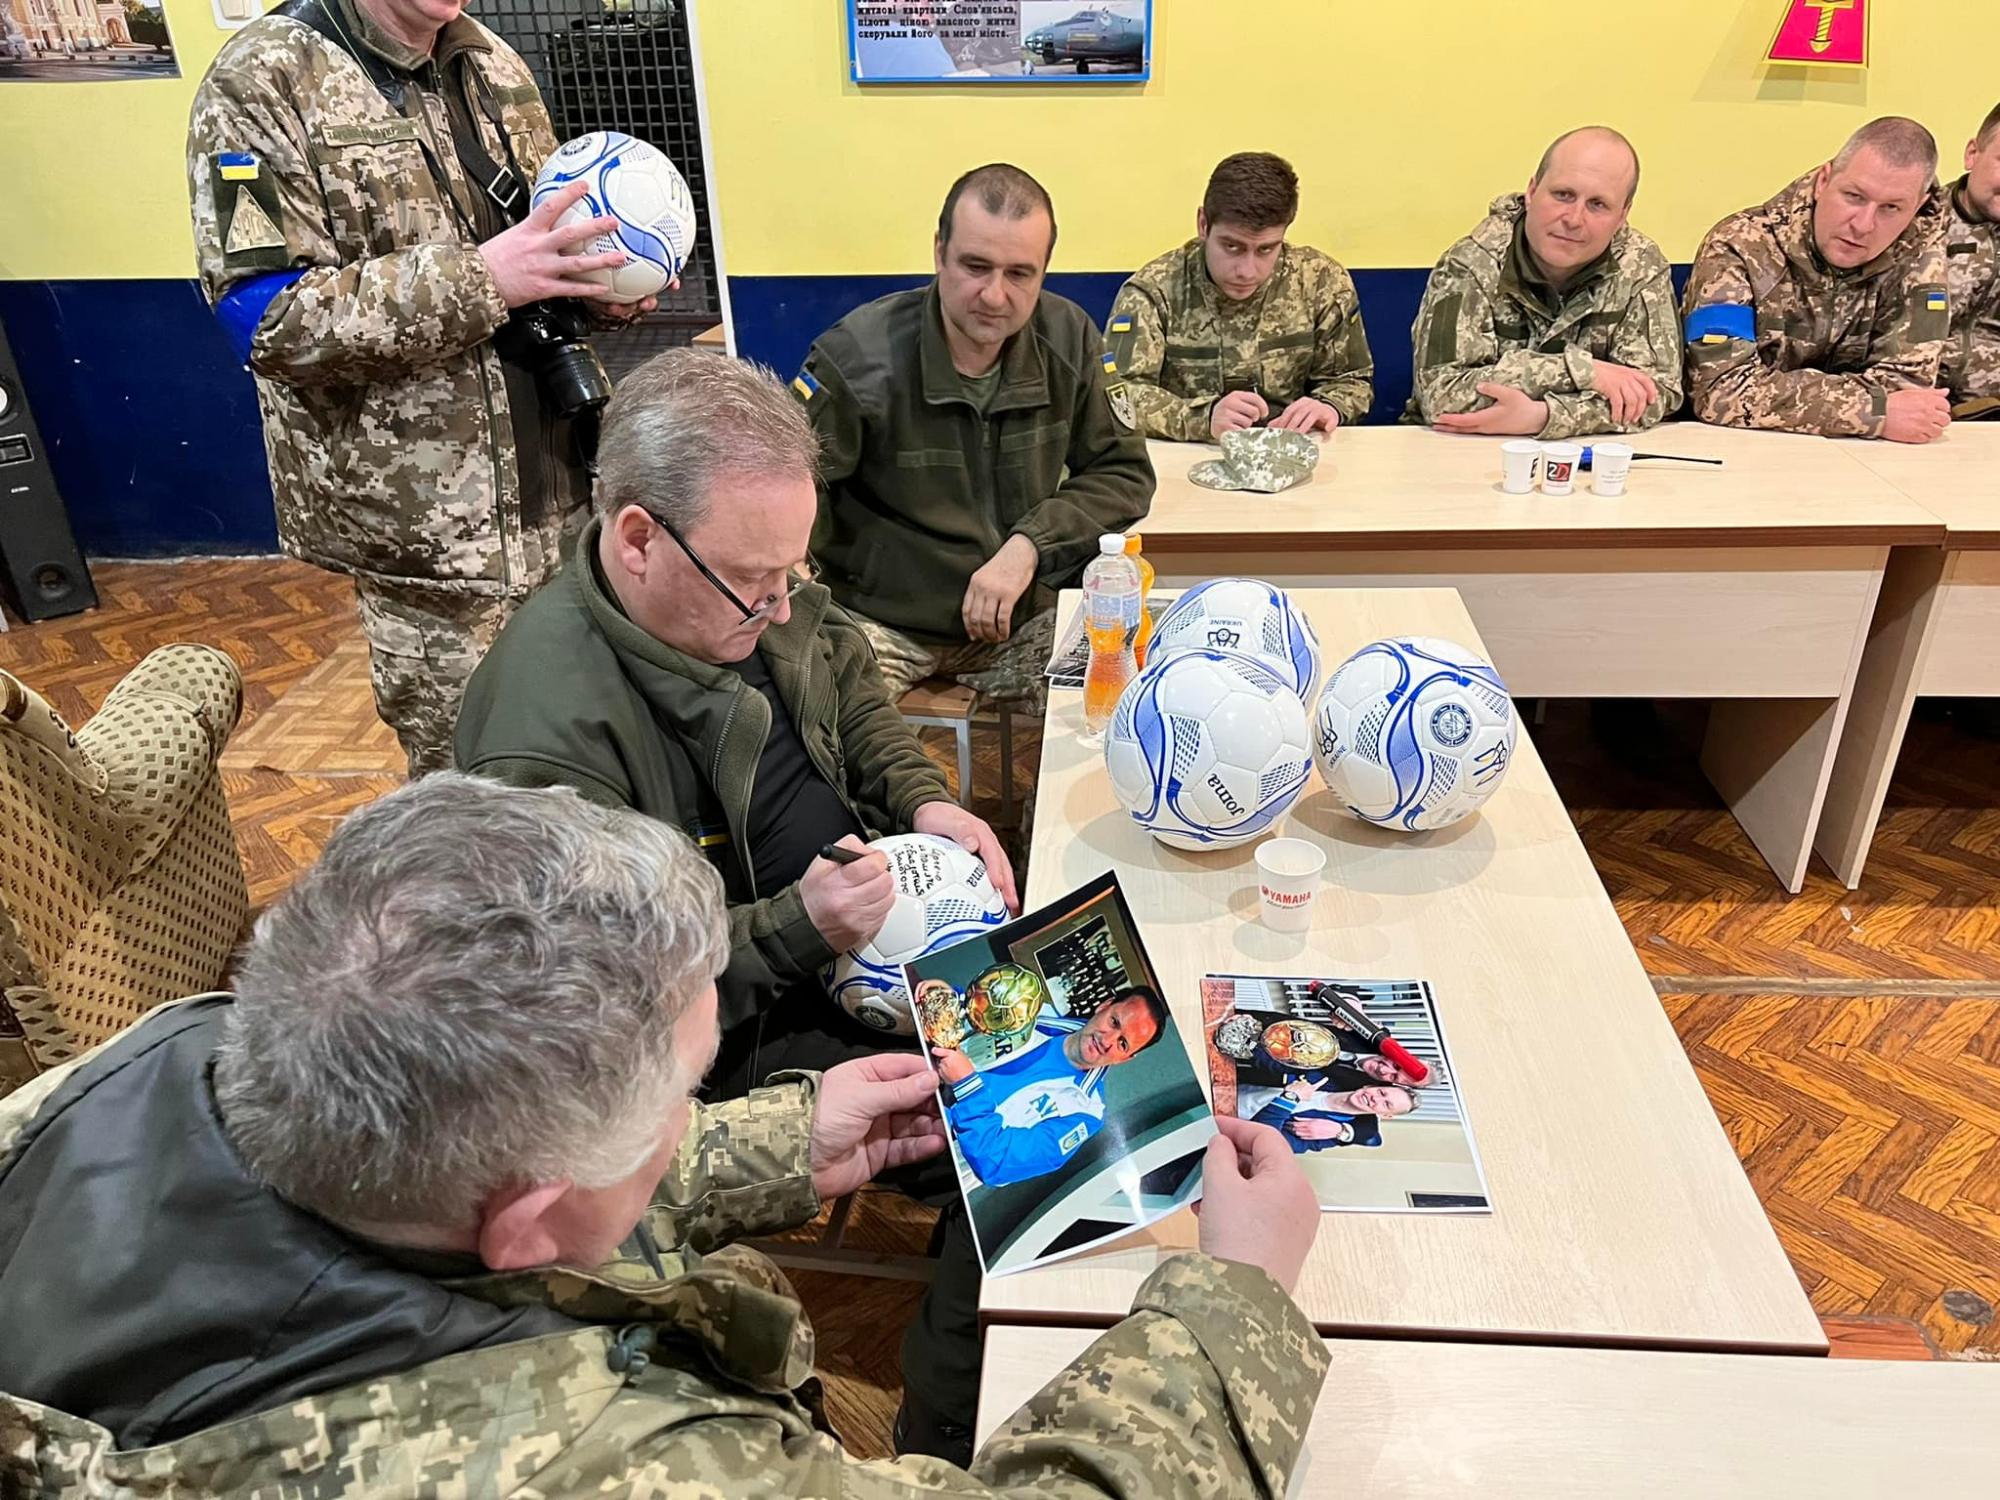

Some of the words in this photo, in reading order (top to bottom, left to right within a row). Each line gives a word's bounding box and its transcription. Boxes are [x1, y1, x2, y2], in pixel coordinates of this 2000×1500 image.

[857, 5, 896, 15] житлові
[903, 6, 947, 17] квартали
[857, 16, 890, 27] пілоти
[899, 16, 930, 28] ціною
[936, 17, 980, 26] власного
[986, 18, 1016, 26] життя
[858, 30, 908, 41] скерували
[939, 30, 950, 38] за
[953, 28, 977, 38] межі
[979, 28, 1010, 38] міста.
[1209, 619, 1242, 627] UKRAINE
[1207, 773, 1245, 816] Joma
[1270, 890, 1312, 905] YAMAHA
